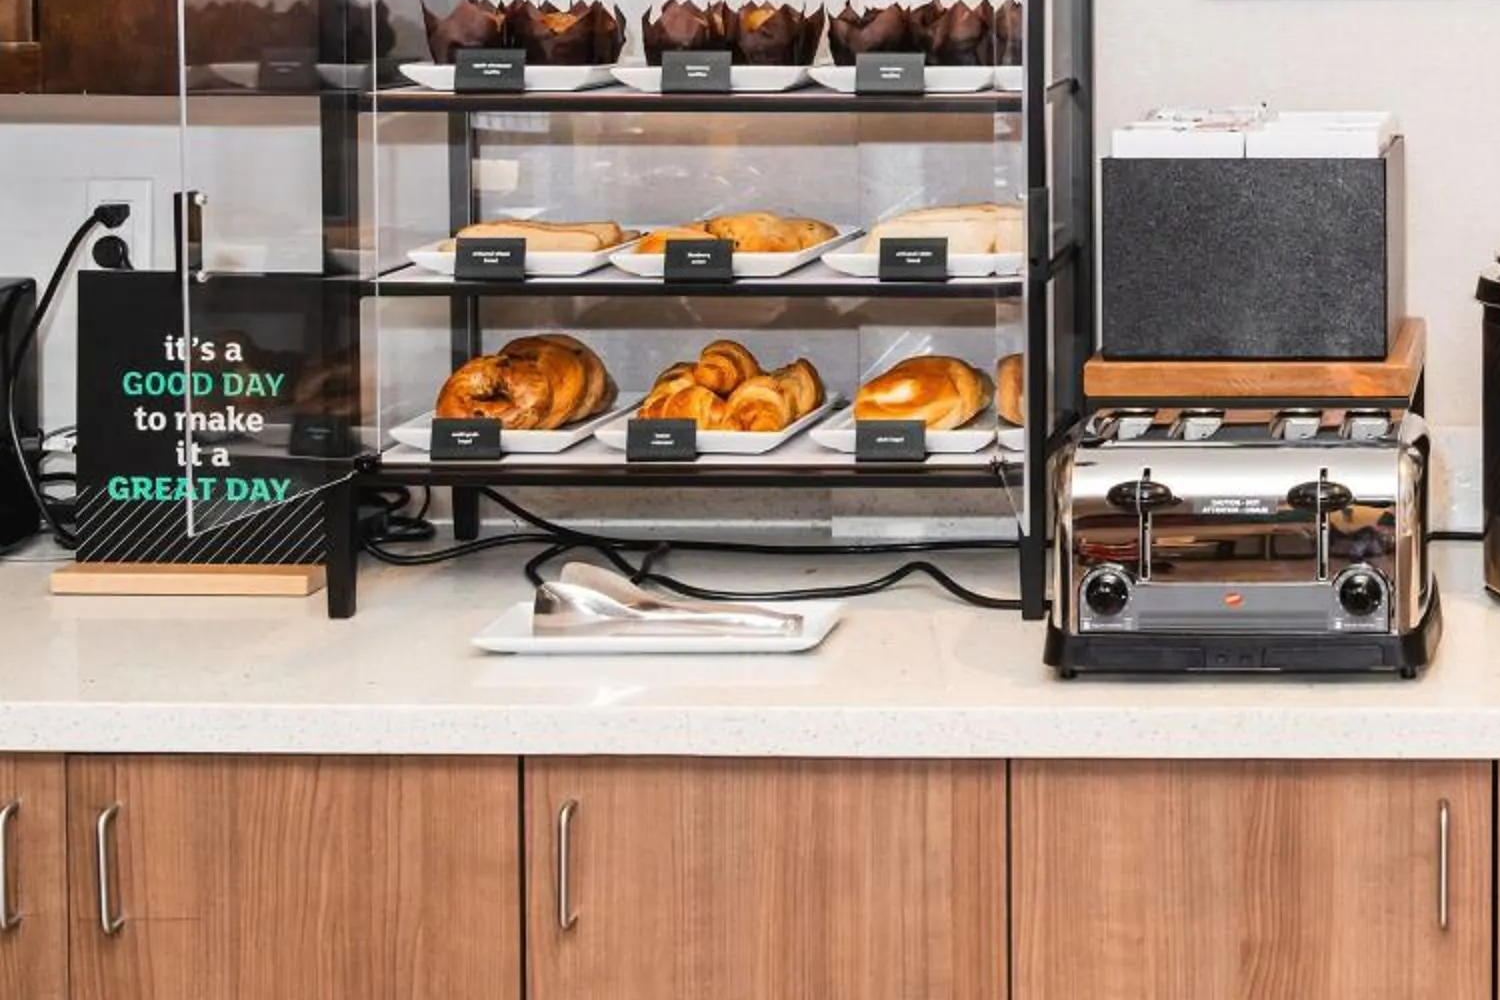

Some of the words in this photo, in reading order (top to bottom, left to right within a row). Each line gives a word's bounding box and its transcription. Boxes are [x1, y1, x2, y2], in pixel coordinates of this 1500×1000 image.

[164, 335, 216, 362] it's
[225, 341, 244, 362] a
[122, 371, 214, 396] GOOD
[222, 373, 285, 397] DAY
[134, 406, 166, 431] to
[175, 406, 264, 431] make
[176, 440, 203, 467] it
[211, 446, 230, 467] a
[107, 476, 216, 501] GREAT
[226, 477, 291, 501] DAY
